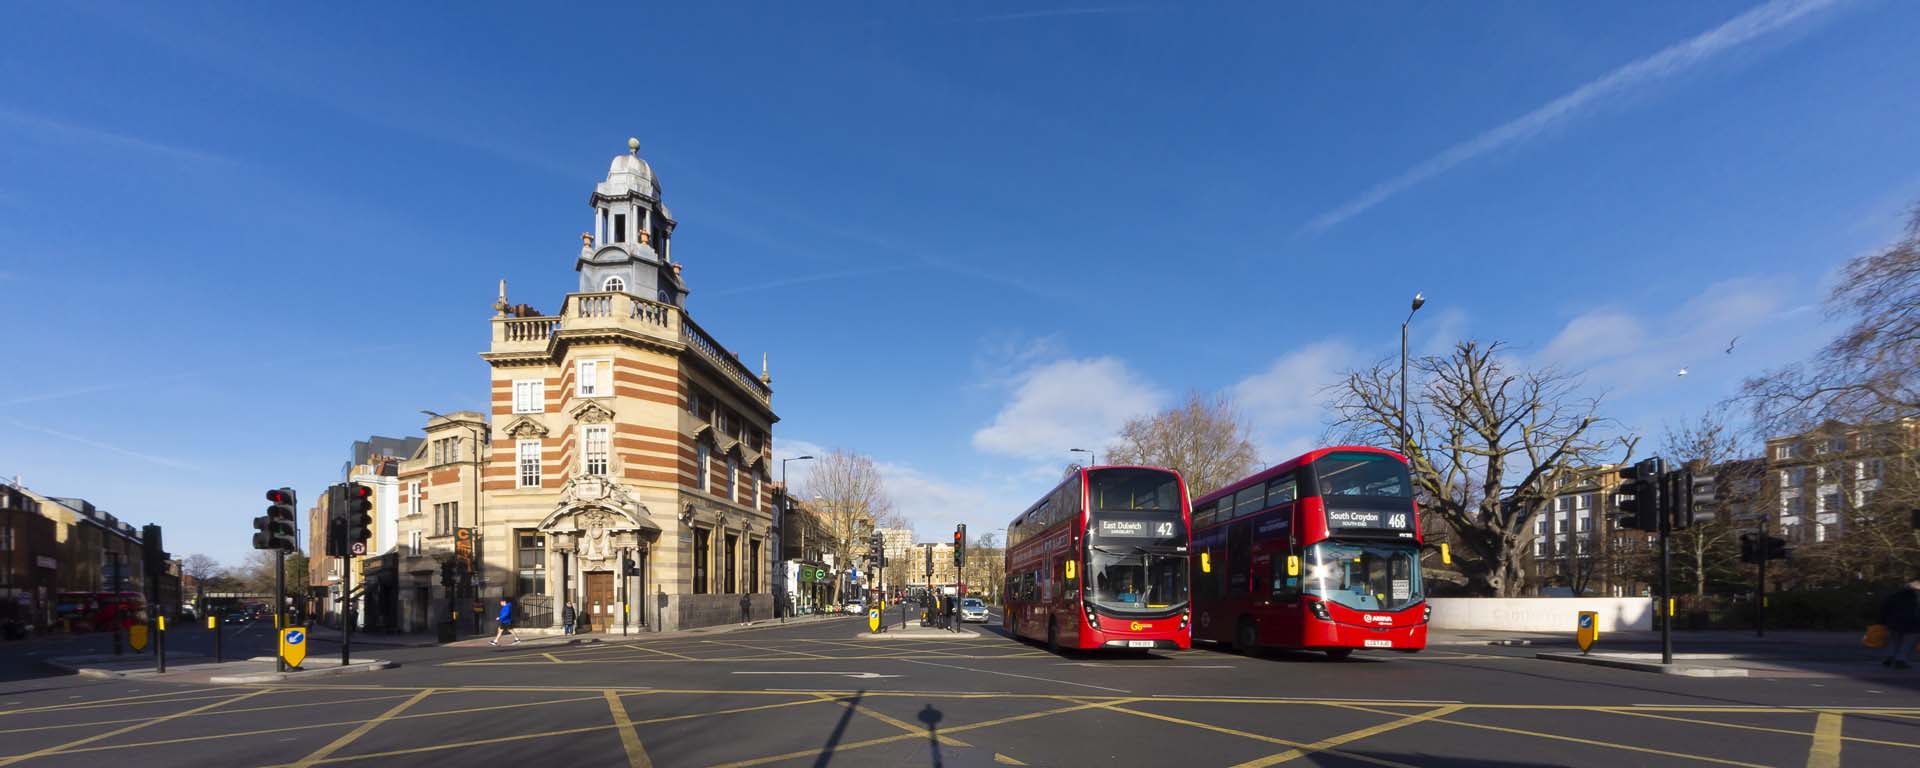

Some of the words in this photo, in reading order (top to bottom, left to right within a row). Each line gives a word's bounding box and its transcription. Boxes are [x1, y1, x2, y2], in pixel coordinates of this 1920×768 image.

[1330, 511, 1350, 520] South
[1351, 512, 1378, 522] Croydon
[1388, 513, 1406, 528] 468
[1103, 521, 1116, 529] East
[1117, 521, 1142, 530] Dulwich
[1157, 522, 1173, 536] 42
